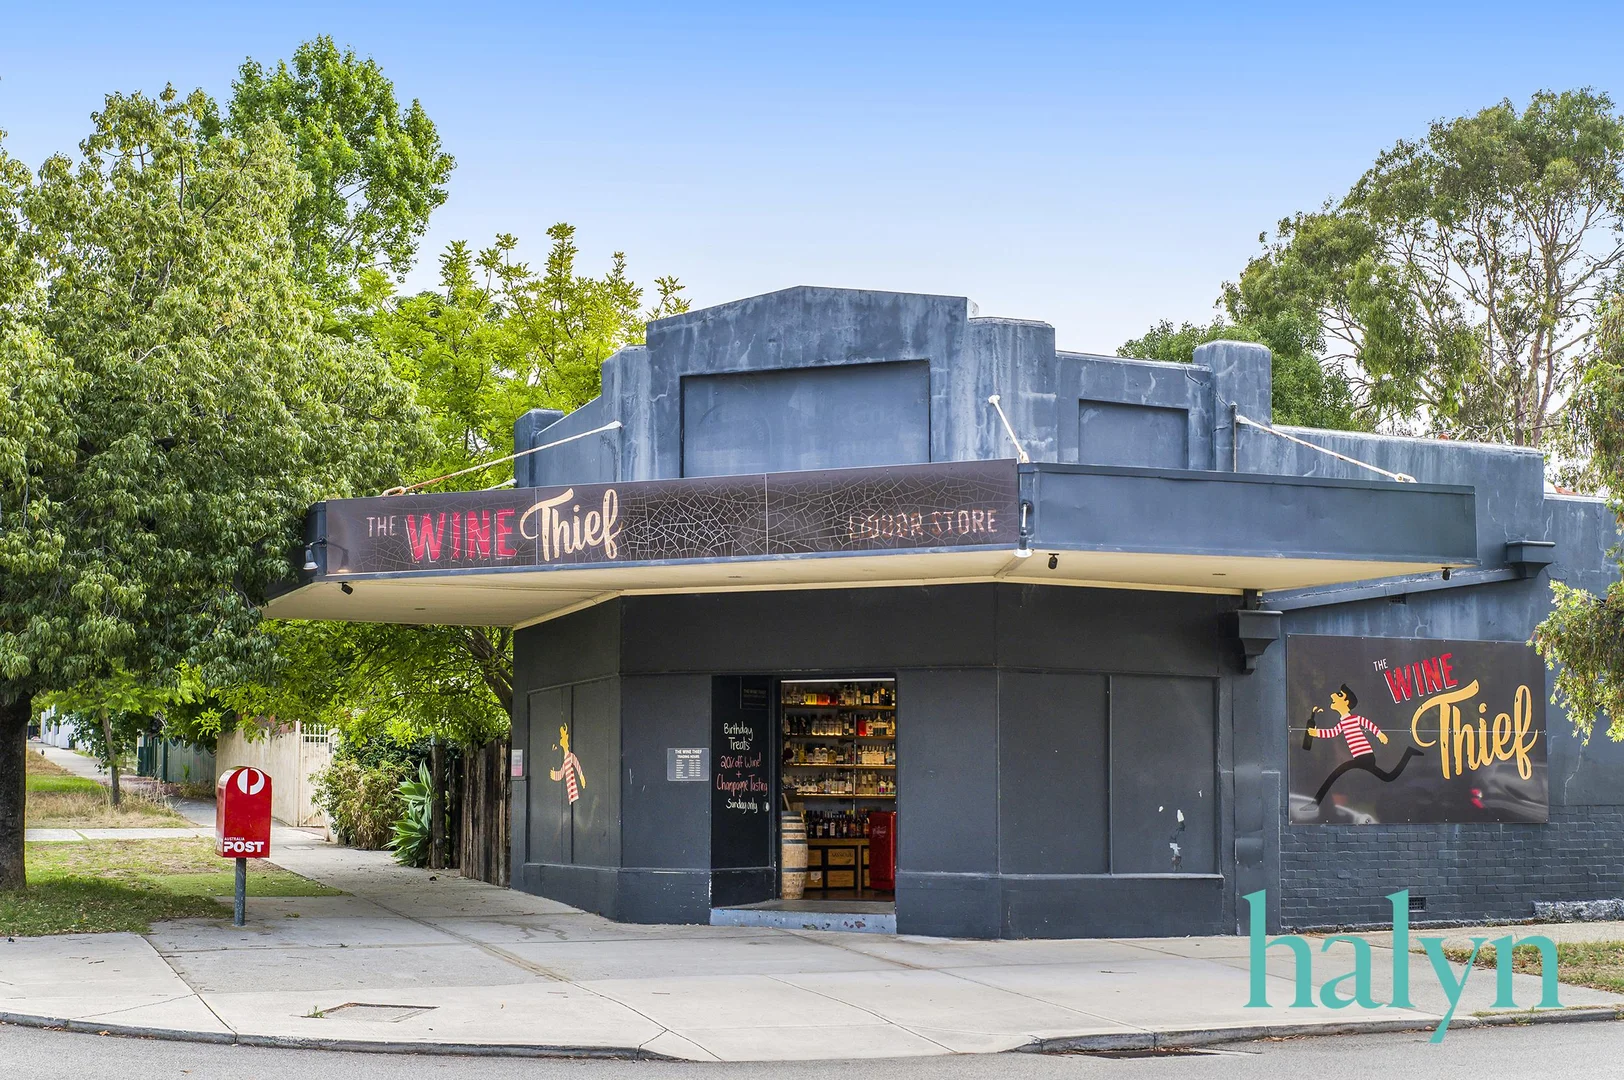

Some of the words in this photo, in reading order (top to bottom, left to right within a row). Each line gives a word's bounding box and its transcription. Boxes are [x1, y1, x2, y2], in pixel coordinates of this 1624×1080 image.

[366, 515, 397, 538] THE
[405, 508, 518, 563] WINE
[519, 487, 624, 562] Thief
[931, 508, 998, 535] STORE
[1372, 658, 1389, 672] THE
[1383, 652, 1459, 704] WINE
[723, 720, 753, 741] Birthday
[1411, 679, 1538, 781] Thief
[728, 736, 750, 750] Treats
[716, 773, 748, 798] Champagne
[748, 773, 768, 797] Tasting
[223, 841, 264, 853] POST
